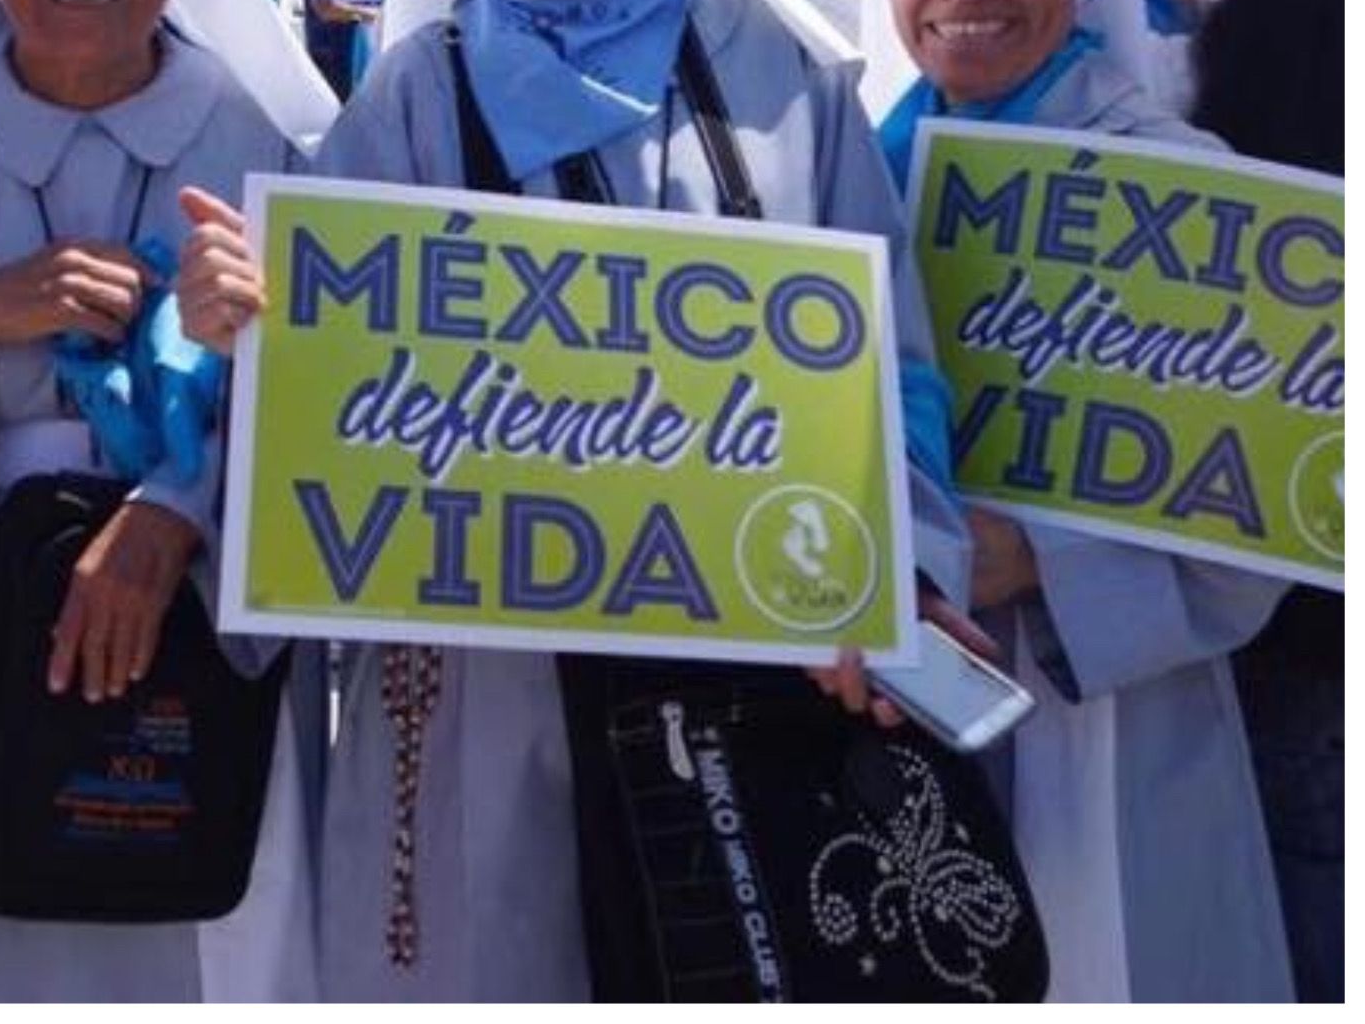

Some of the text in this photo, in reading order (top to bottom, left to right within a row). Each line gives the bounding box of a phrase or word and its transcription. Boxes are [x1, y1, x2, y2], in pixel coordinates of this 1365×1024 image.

[288, 210, 866, 373] MÉXICO
[933, 147, 1345, 308] MÉXIC
[959, 265, 1345, 412] defiende la
[338, 352, 782, 476] defiende la
[295, 479, 721, 624] VIDA
[695, 748, 741, 835] MIKO
